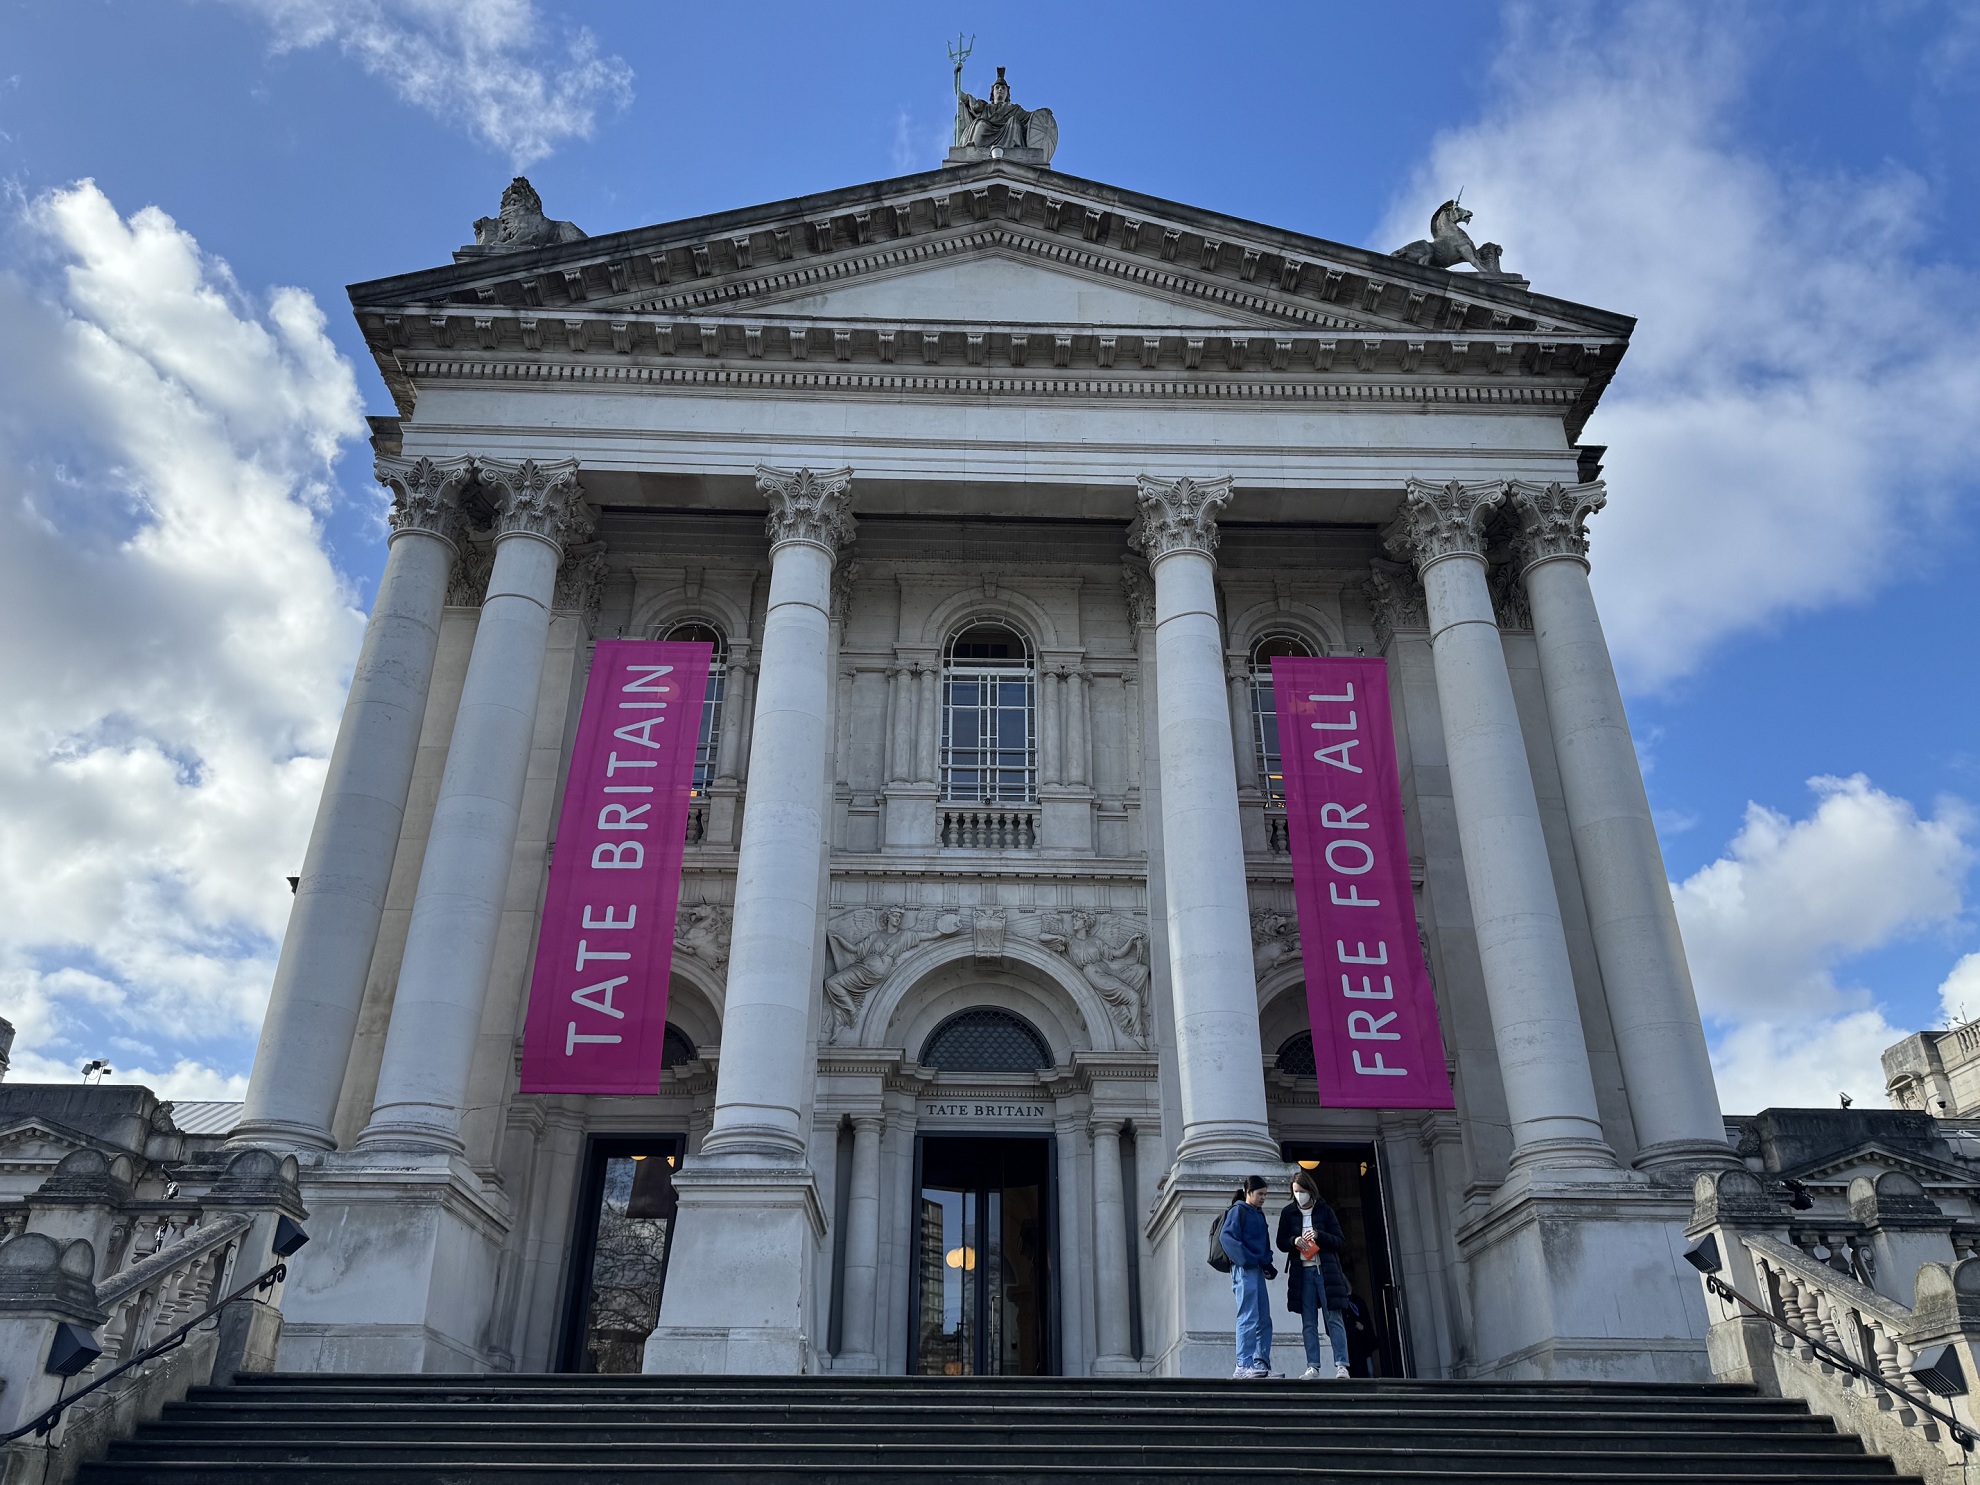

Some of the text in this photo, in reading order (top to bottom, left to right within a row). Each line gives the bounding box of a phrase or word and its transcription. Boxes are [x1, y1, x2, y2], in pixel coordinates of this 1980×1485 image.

[565, 665, 674, 1056] TATE BRITAIN
[1308, 682, 1408, 1076] FREE FOR ALL
[926, 1104, 1045, 1117] TATE BRITAIN
